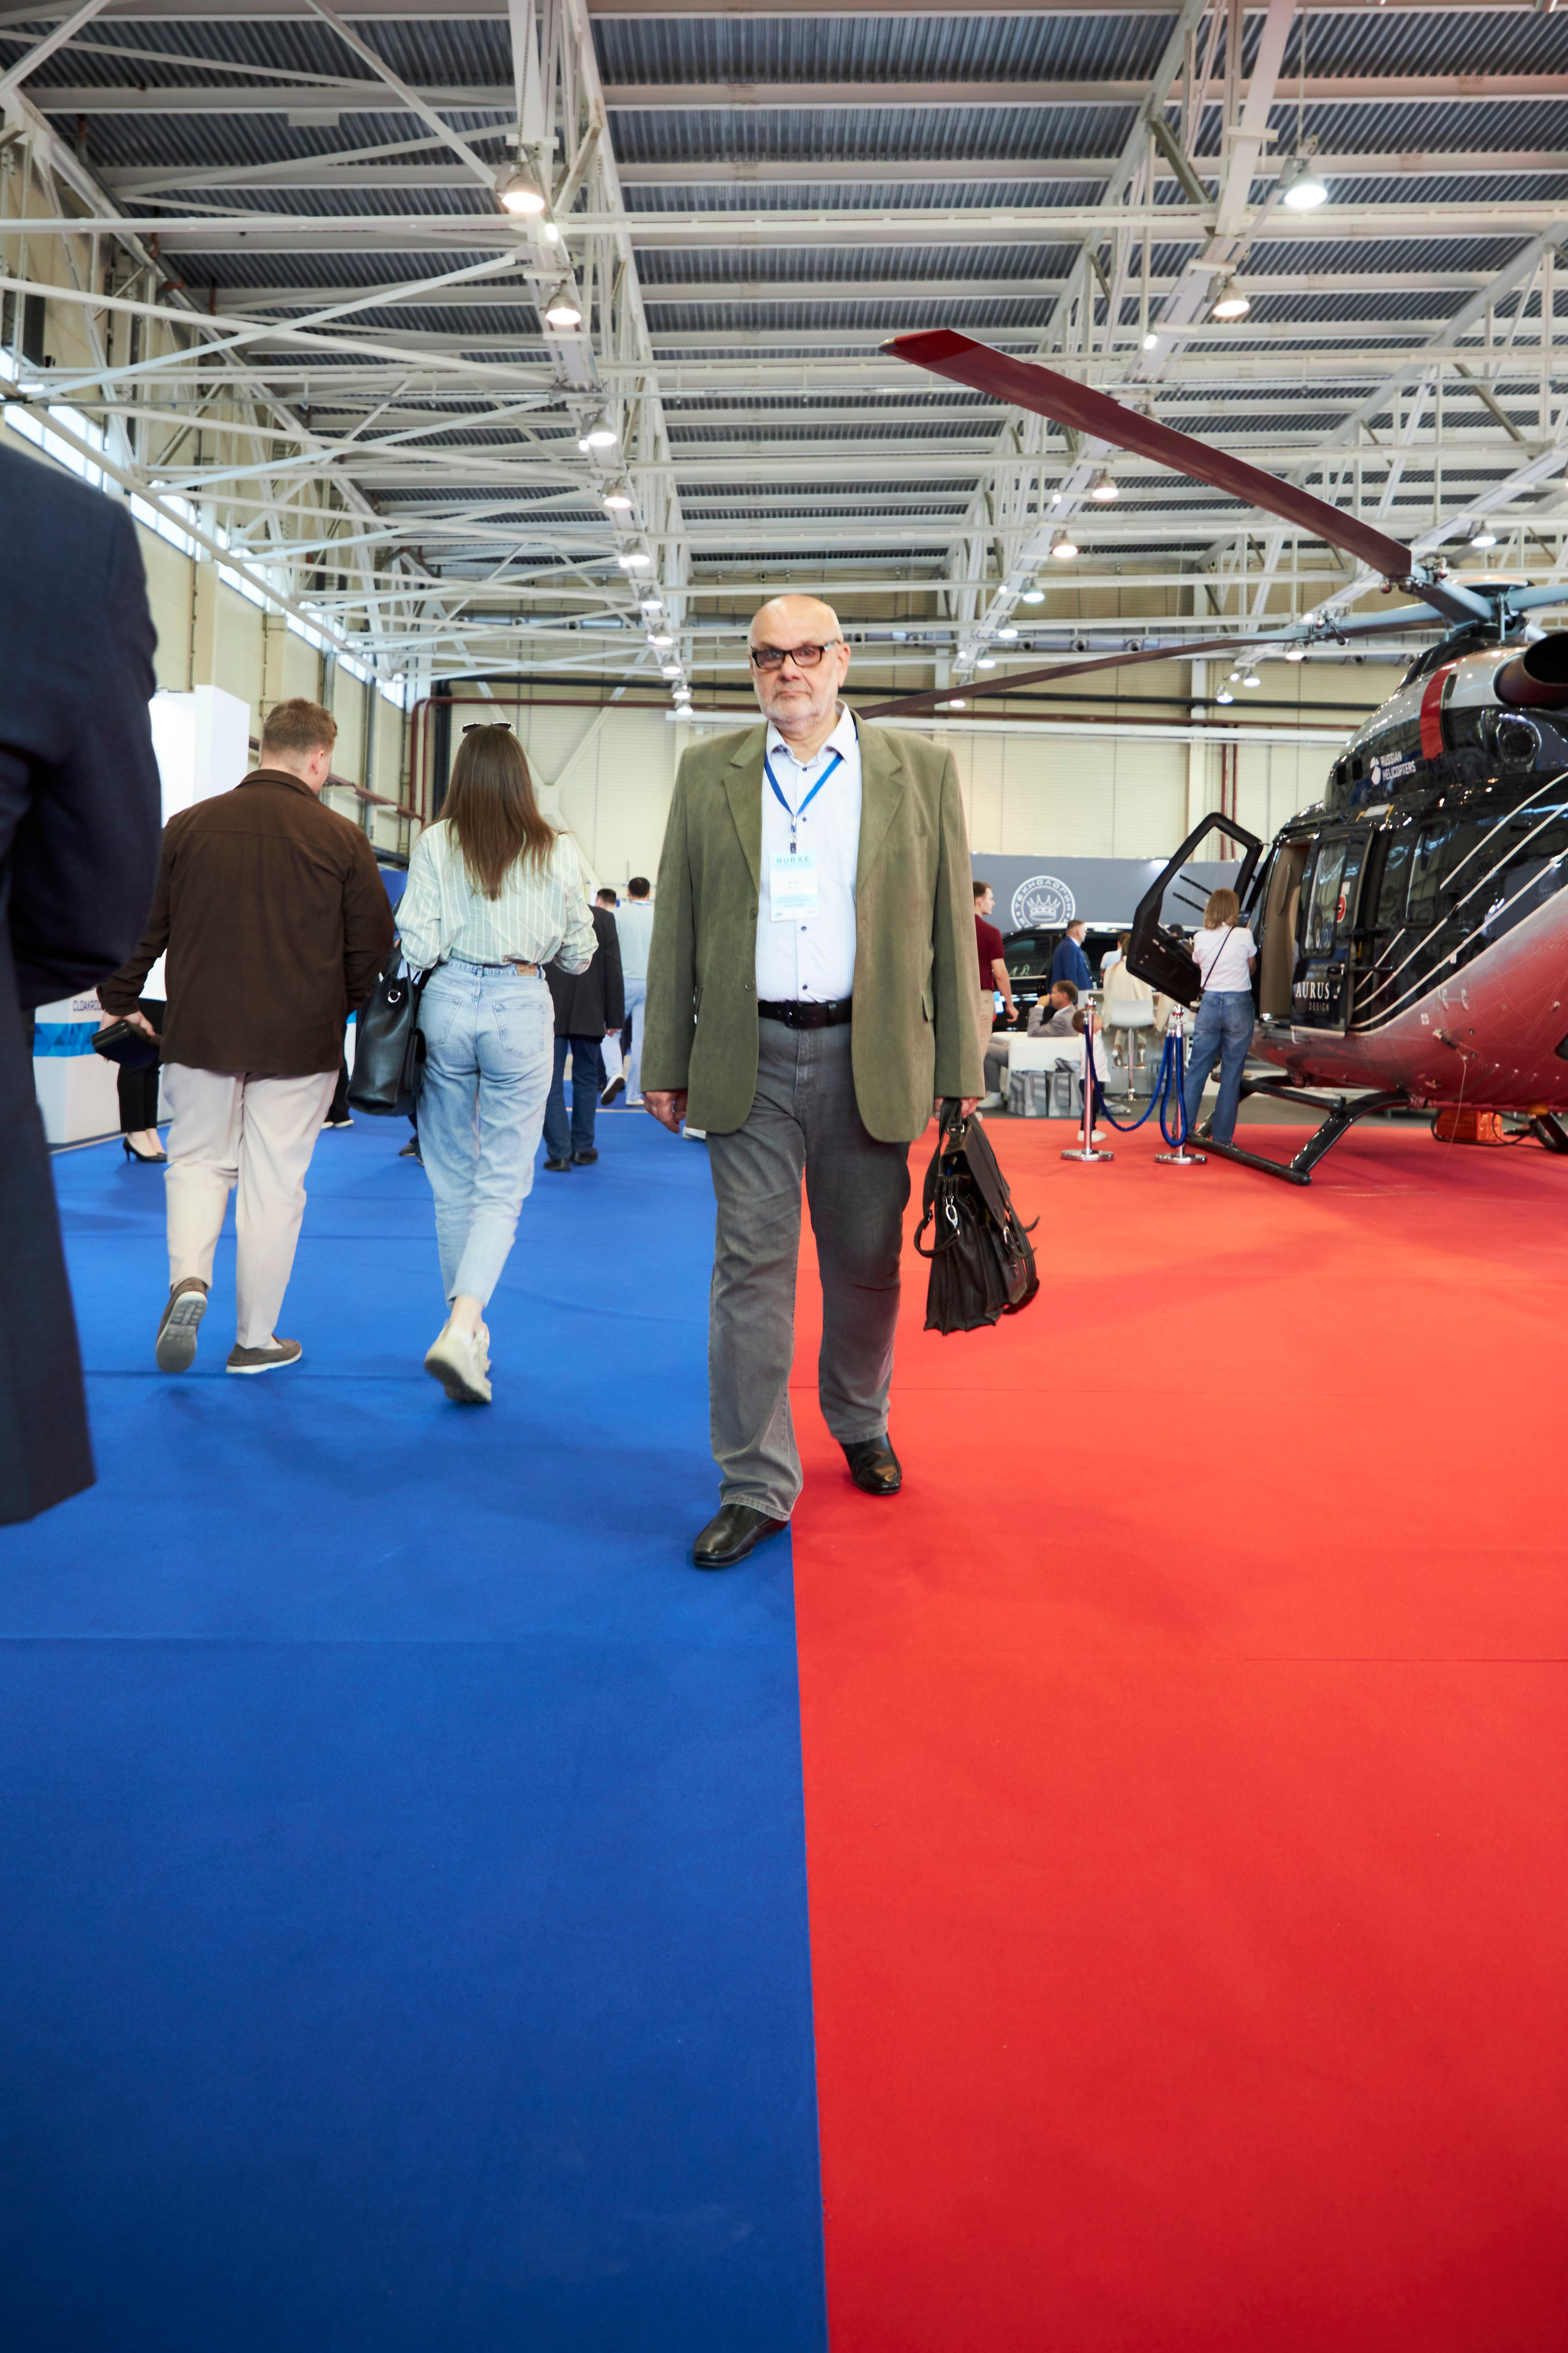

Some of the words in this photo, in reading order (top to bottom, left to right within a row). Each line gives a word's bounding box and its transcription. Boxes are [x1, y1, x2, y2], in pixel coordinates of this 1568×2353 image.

[1380, 750, 1402, 767] RUSSIAN
[1382, 760, 1416, 781] HELICOPTERS
[1016, 879, 1072, 911] ТЕХНОЛОГИИ
[1295, 981, 1330, 999] AURUS
[1308, 1001, 1330, 1011] DESIGN
